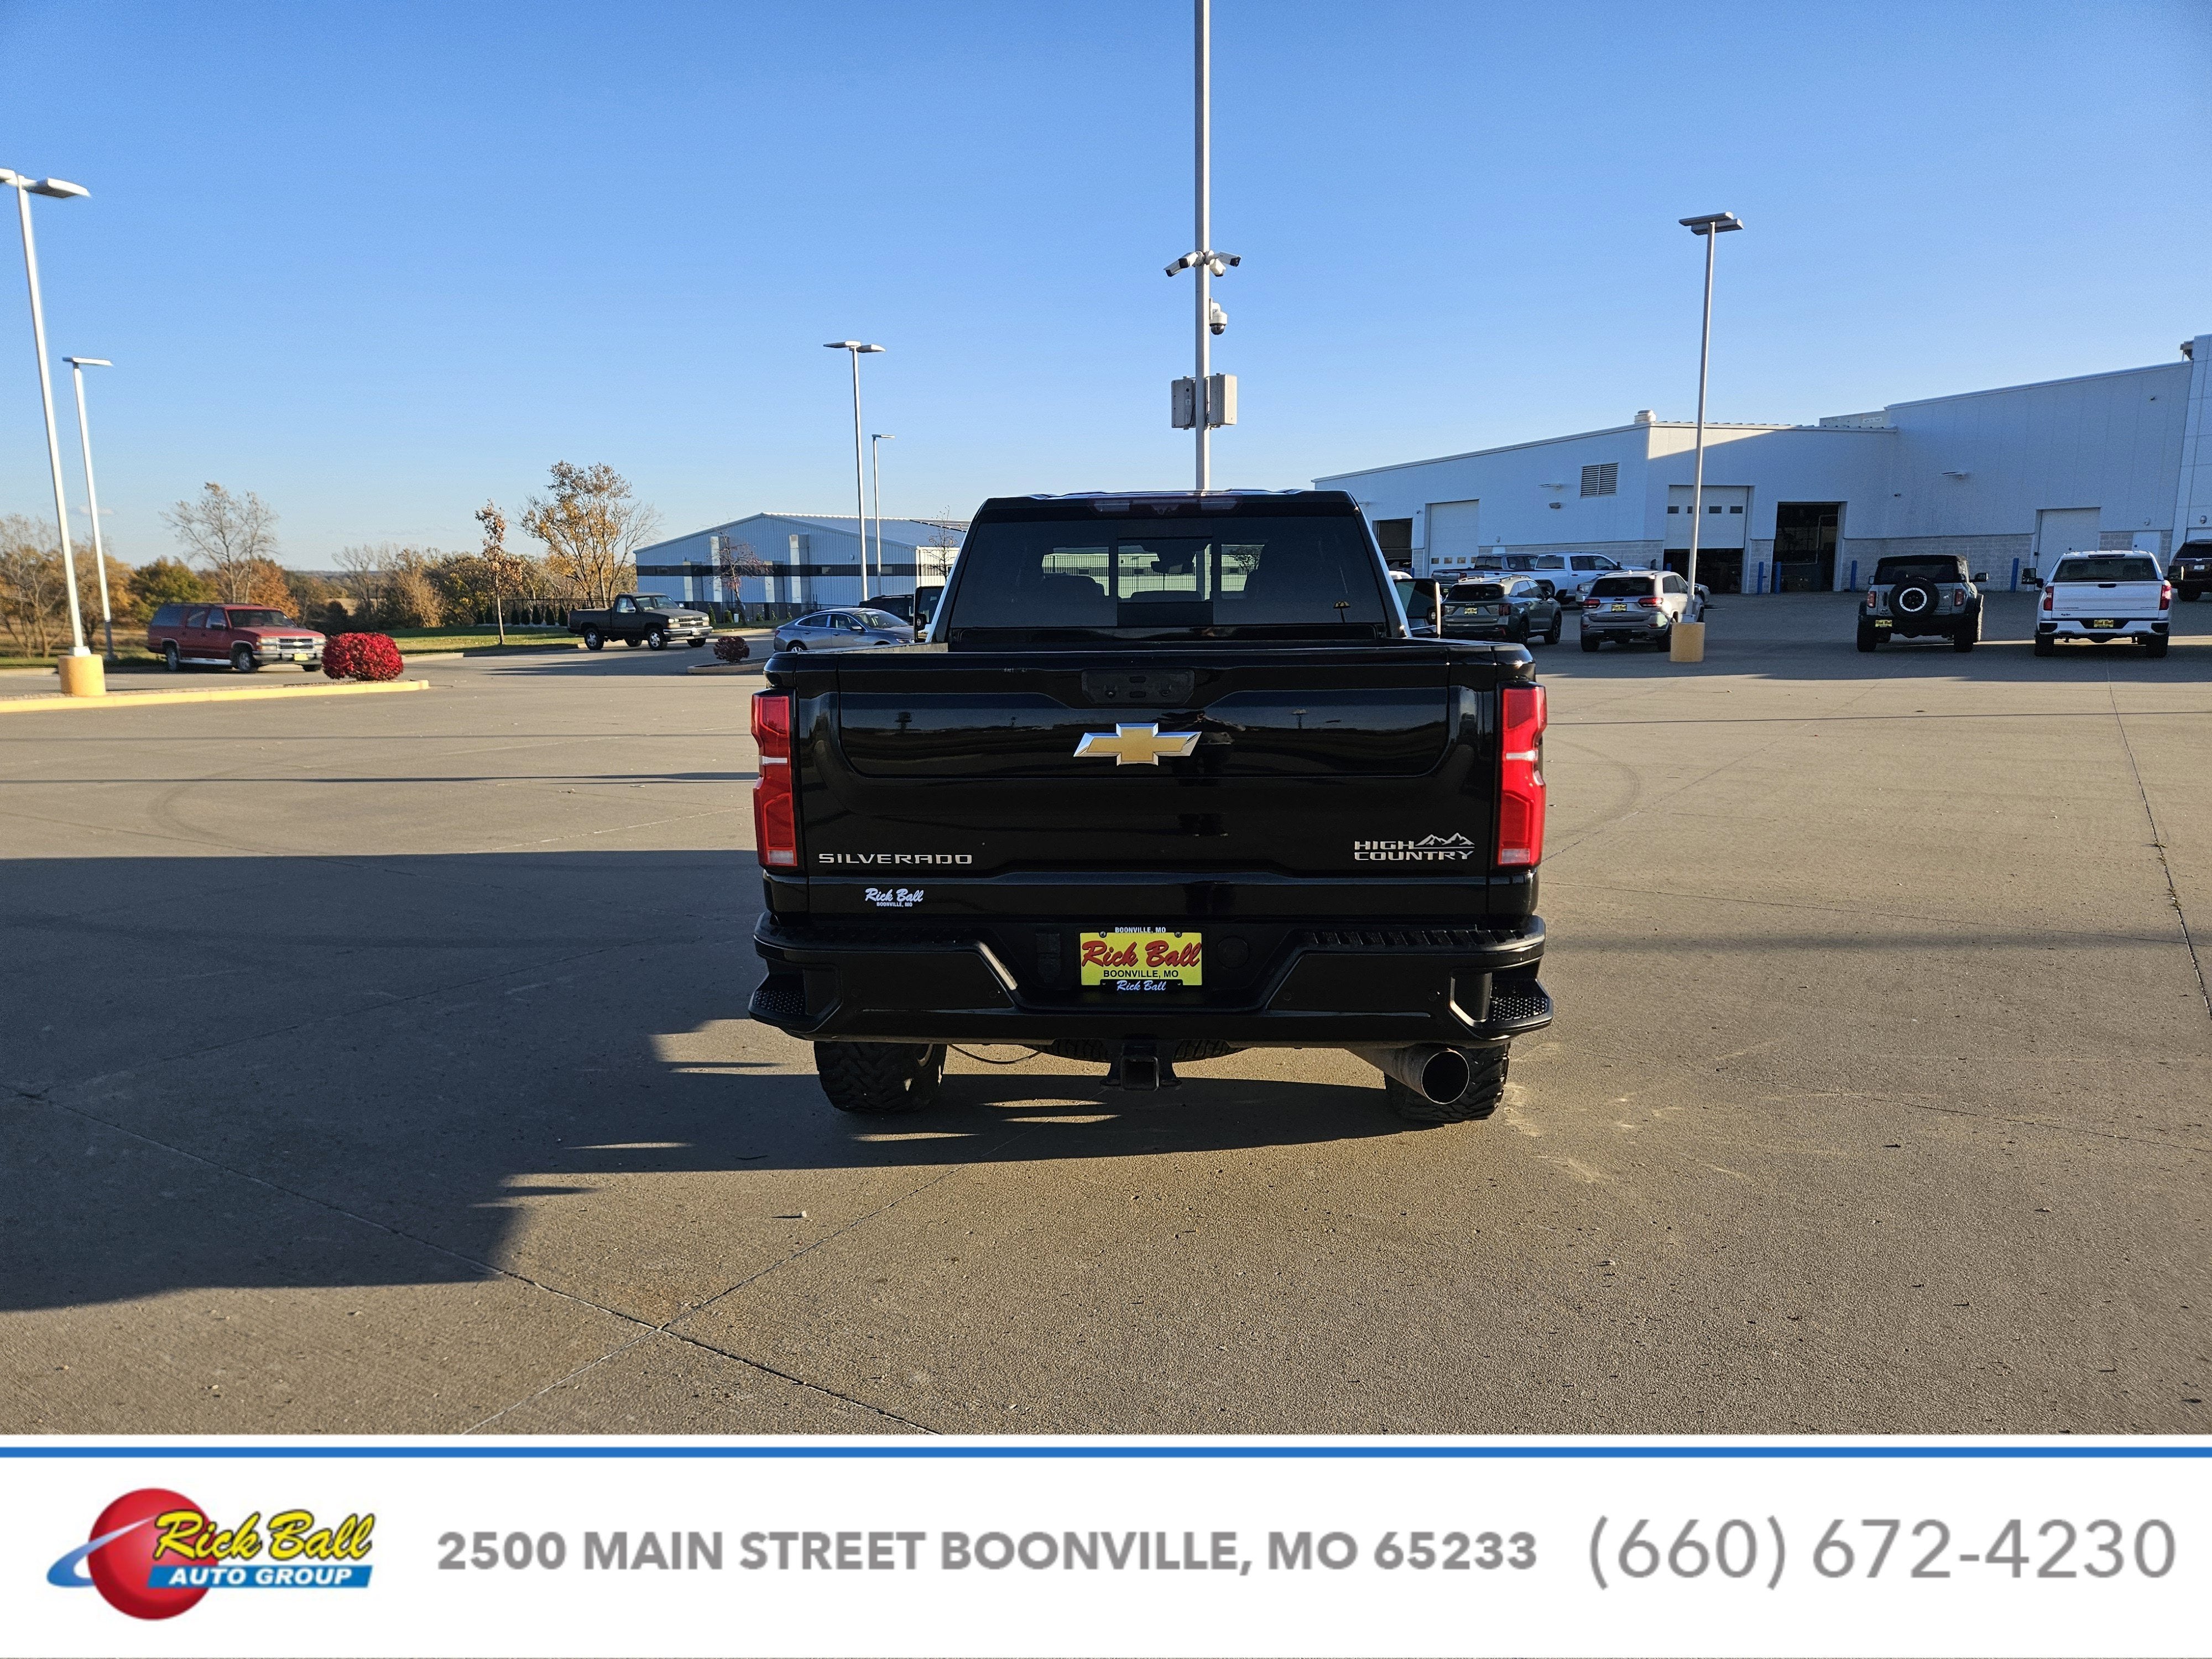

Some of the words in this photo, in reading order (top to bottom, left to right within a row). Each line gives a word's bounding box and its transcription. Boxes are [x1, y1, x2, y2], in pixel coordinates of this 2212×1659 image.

[1354, 841, 1414, 850] HIGH
[818, 853, 972, 864] SILVERADO
[1354, 851, 1474, 860] COUNTRY
[865, 888, 893, 902] Rick
[896, 888, 924, 902] Ball
[1081, 940, 1139, 967] Rick
[1145, 940, 1202, 967] Ball
[1103, 970, 1161, 979] BOONVILLE,
[1117, 980, 1141, 991] Rick
[1143, 980, 1167, 991] Ball
